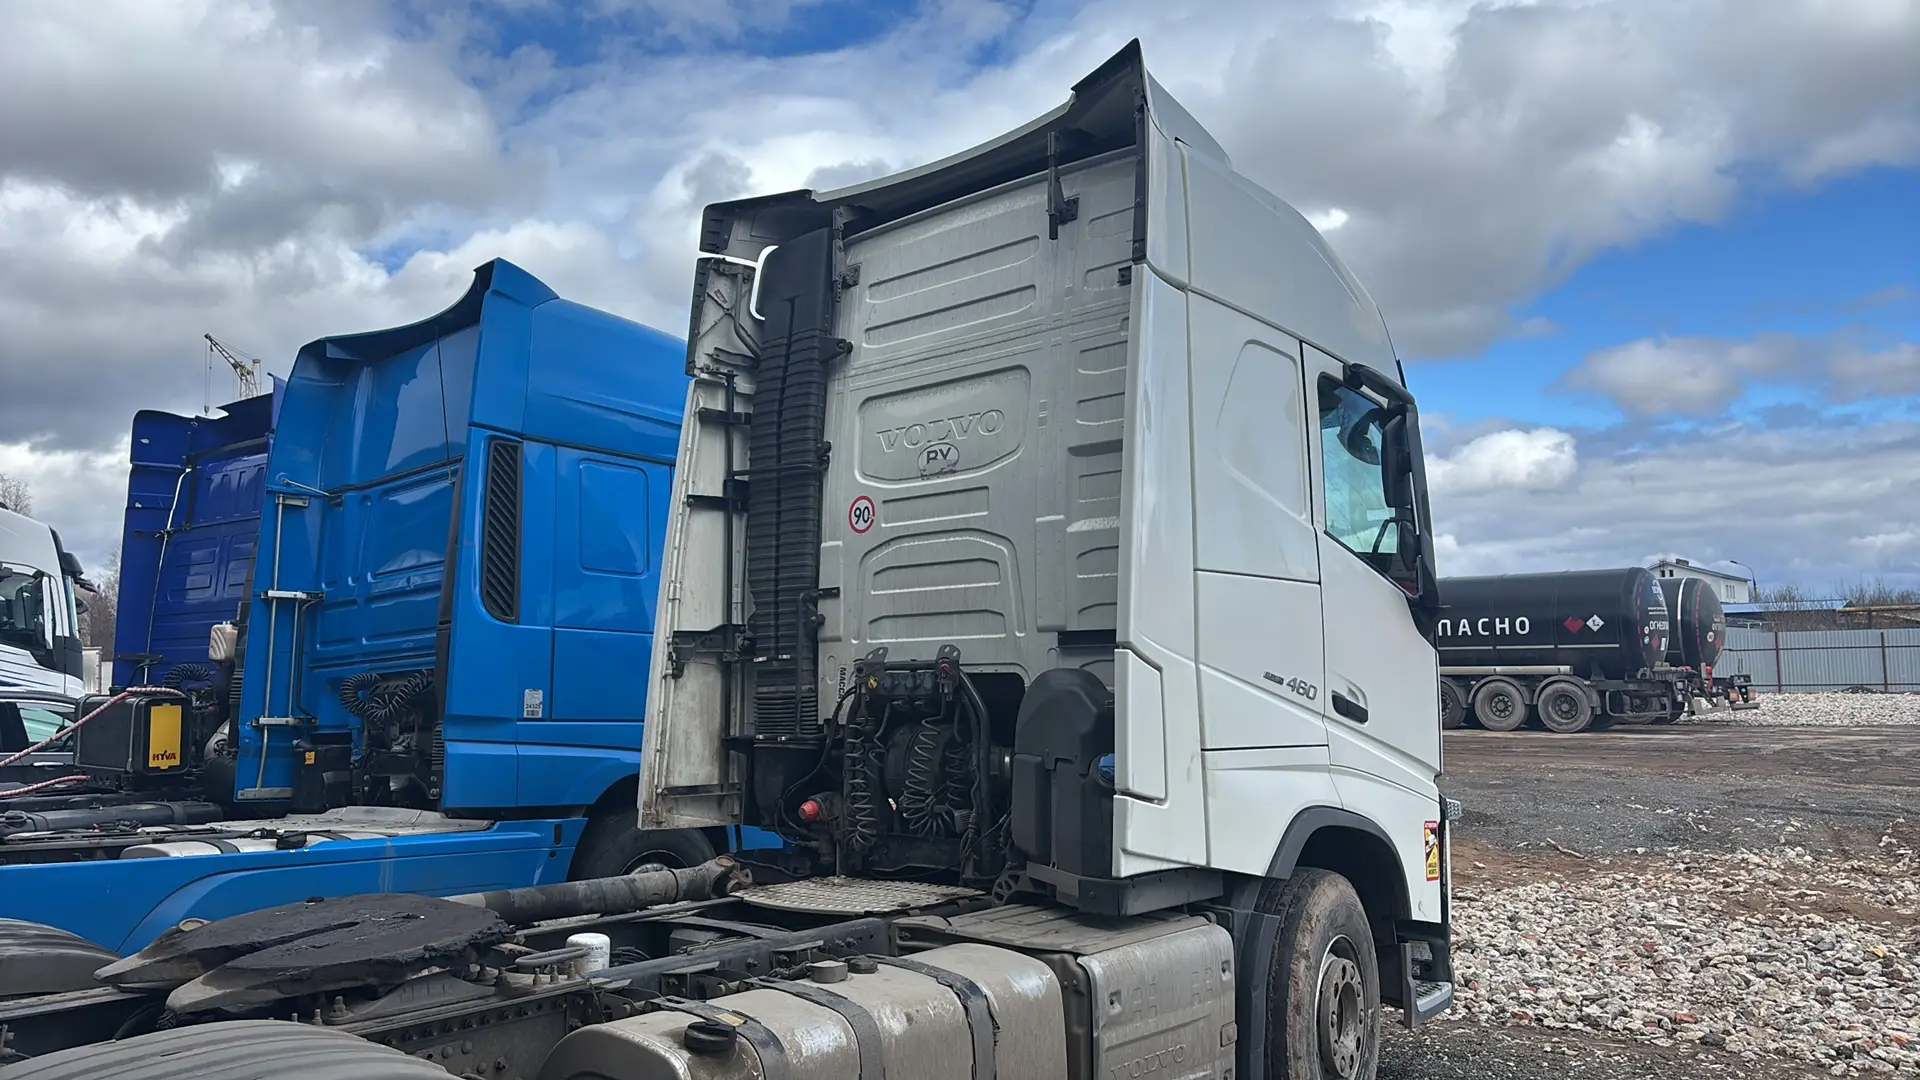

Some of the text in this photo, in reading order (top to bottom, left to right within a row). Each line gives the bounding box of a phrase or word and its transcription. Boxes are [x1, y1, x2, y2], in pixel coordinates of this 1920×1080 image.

[876, 409, 1005, 453] VOLVO
[853, 506, 871, 525] 90
[1286, 677, 1318, 701] 460
[152, 749, 177, 761] HYVA
[1110, 1043, 1187, 1080] VOLVO
